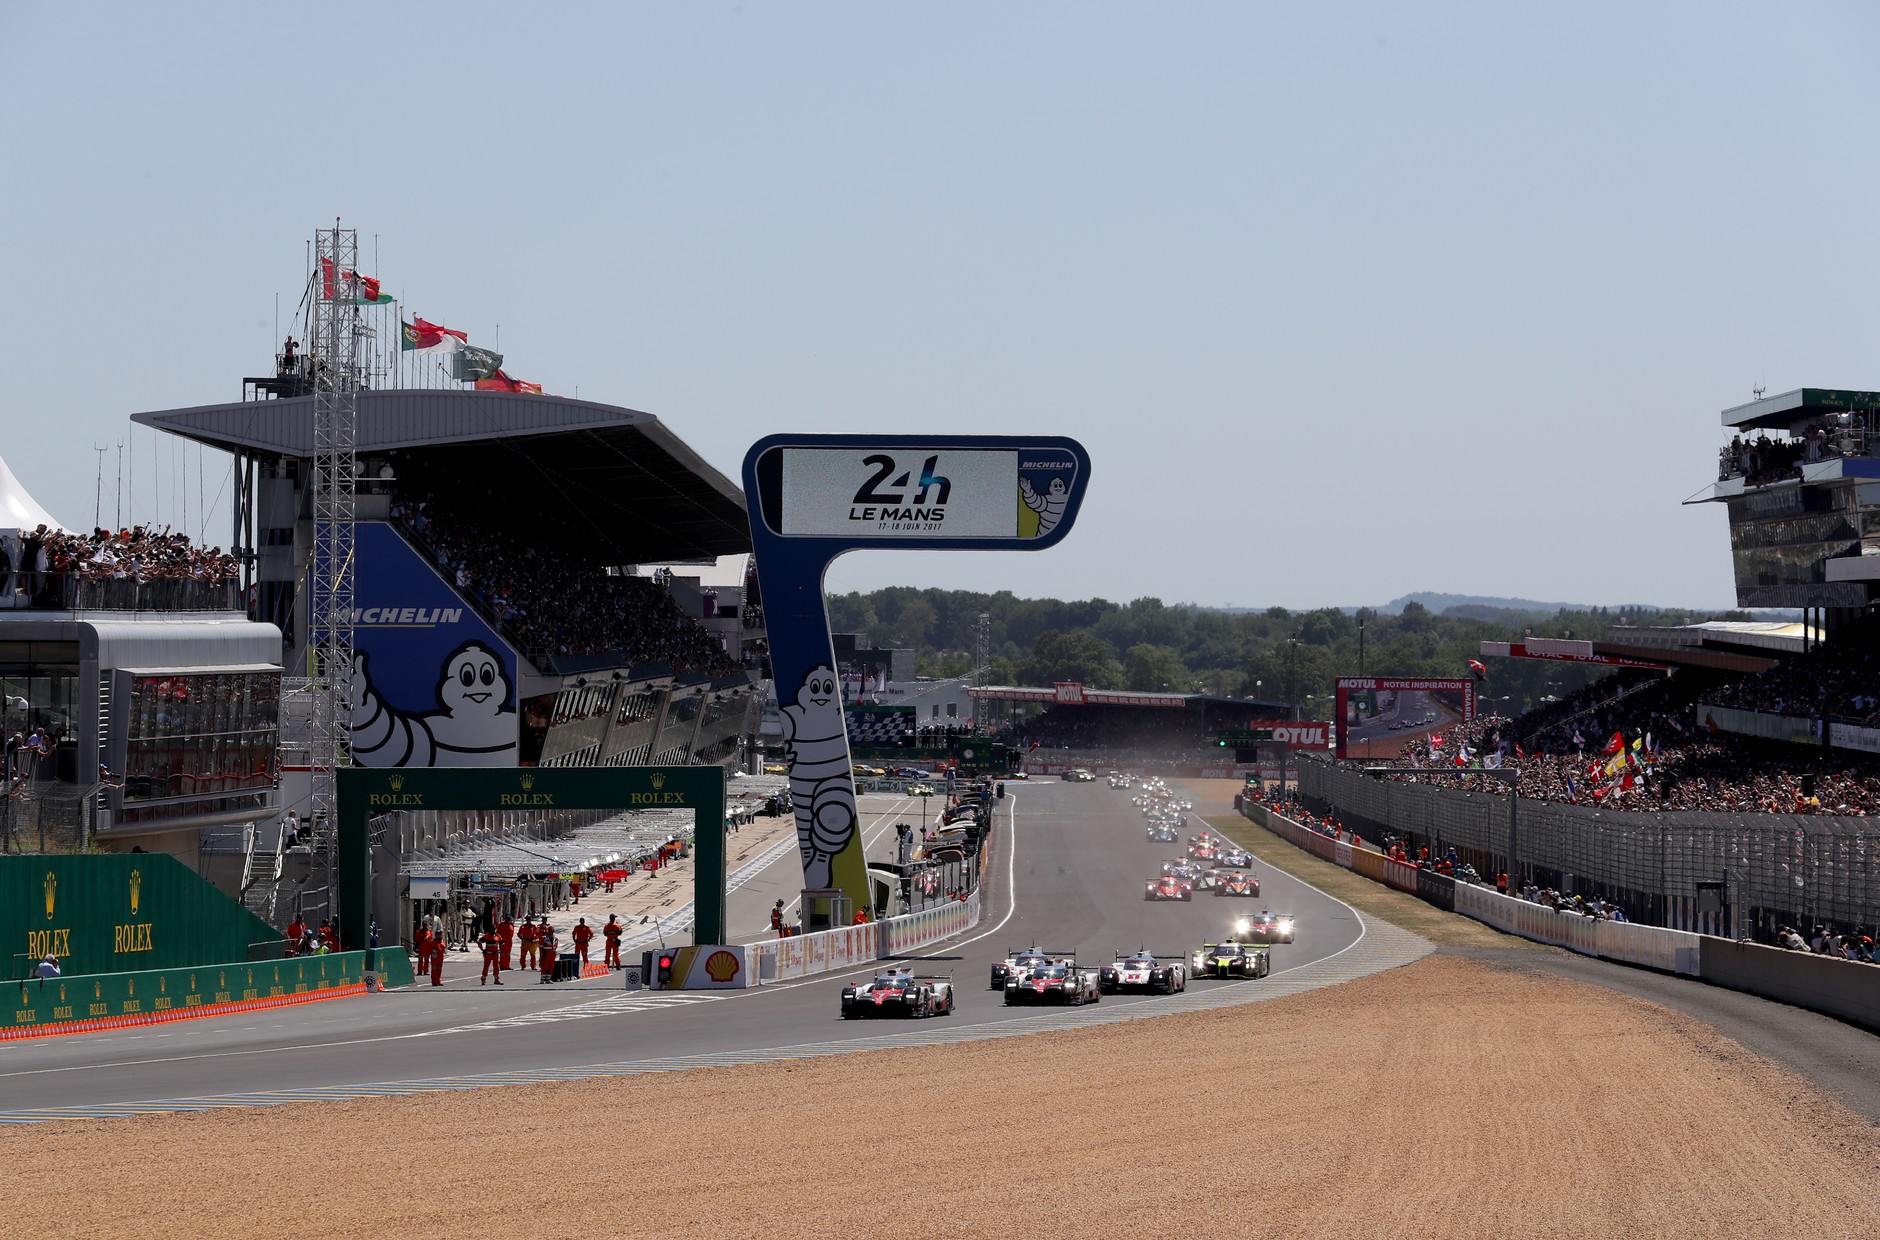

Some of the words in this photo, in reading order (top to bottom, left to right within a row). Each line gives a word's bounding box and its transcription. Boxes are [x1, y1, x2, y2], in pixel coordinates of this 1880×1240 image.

[1022, 461, 1074, 469] MICHELIN
[853, 454, 951, 505] 24h
[849, 507, 876, 521] LE
[880, 507, 945, 521] MANS
[878, 522, 901, 531] 17-18
[903, 522, 922, 531] JUIN
[923, 523, 942, 532] 2017
[1338, 679, 1377, 689] MOTUL
[1383, 681, 1410, 689] NOTRE
[1411, 681, 1462, 689] INSPIRATION
[1058, 684, 1083, 701] MOTUL
[1257, 727, 1325, 745] OTUL
[1201, 769, 1227, 778] MOTUL
[369, 794, 424, 806] ROLEX
[499, 794, 554, 805] ROLEX
[631, 792, 684, 804] ROLEX
[28, 928, 71, 960] ROLEX
[114, 923, 153, 953] ROLEX
[16, 1009, 36, 1023] ROLEX
[53, 1006, 73, 1019] ROLEX
[89, 1003, 108, 1016] ROLEX
